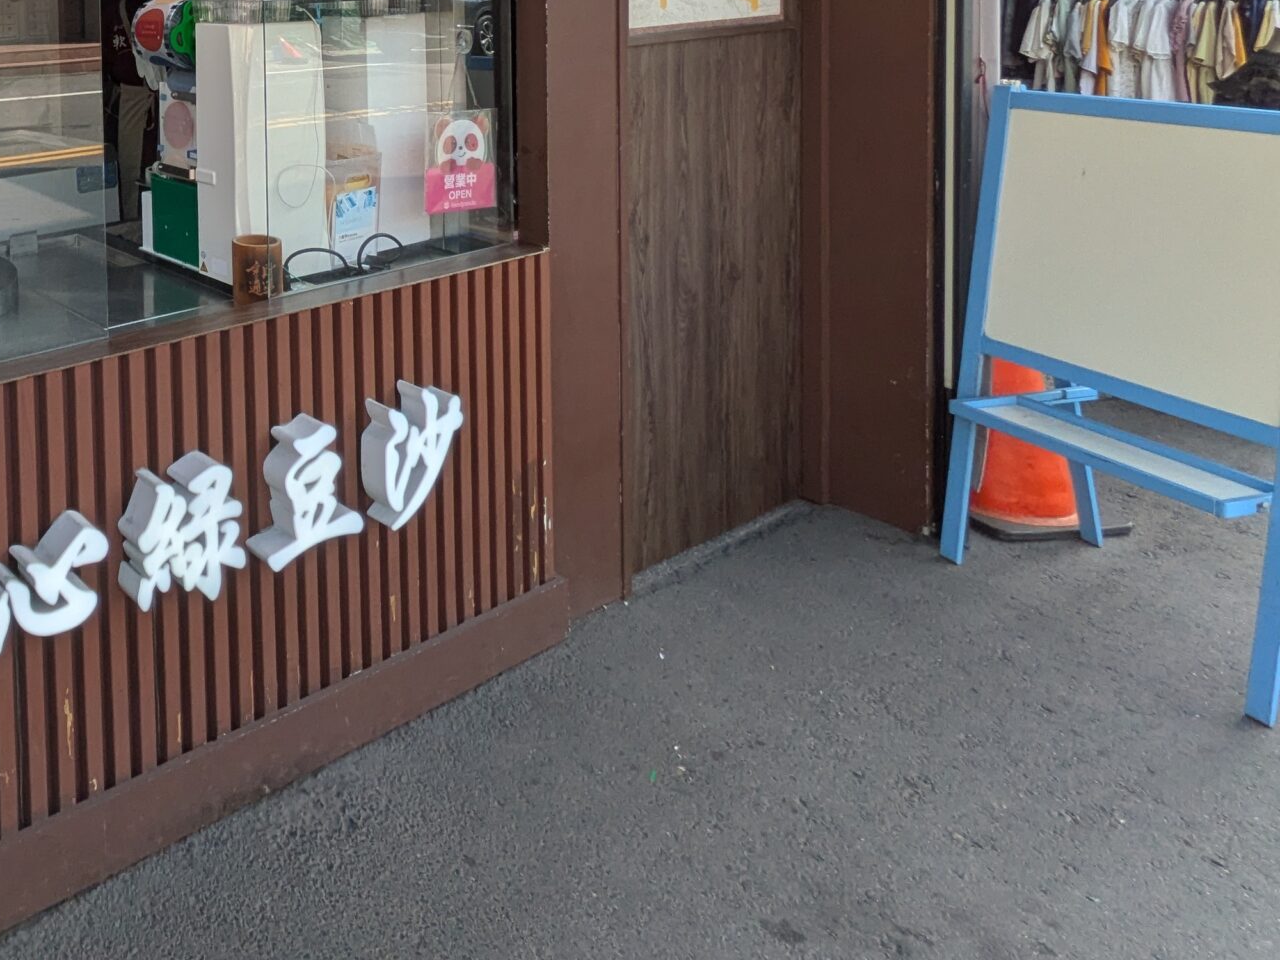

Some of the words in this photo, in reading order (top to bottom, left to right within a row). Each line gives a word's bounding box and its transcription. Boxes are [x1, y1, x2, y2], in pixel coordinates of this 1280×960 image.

[444, 172, 477, 190] 營業中
[448, 189, 472, 200] OPEN
